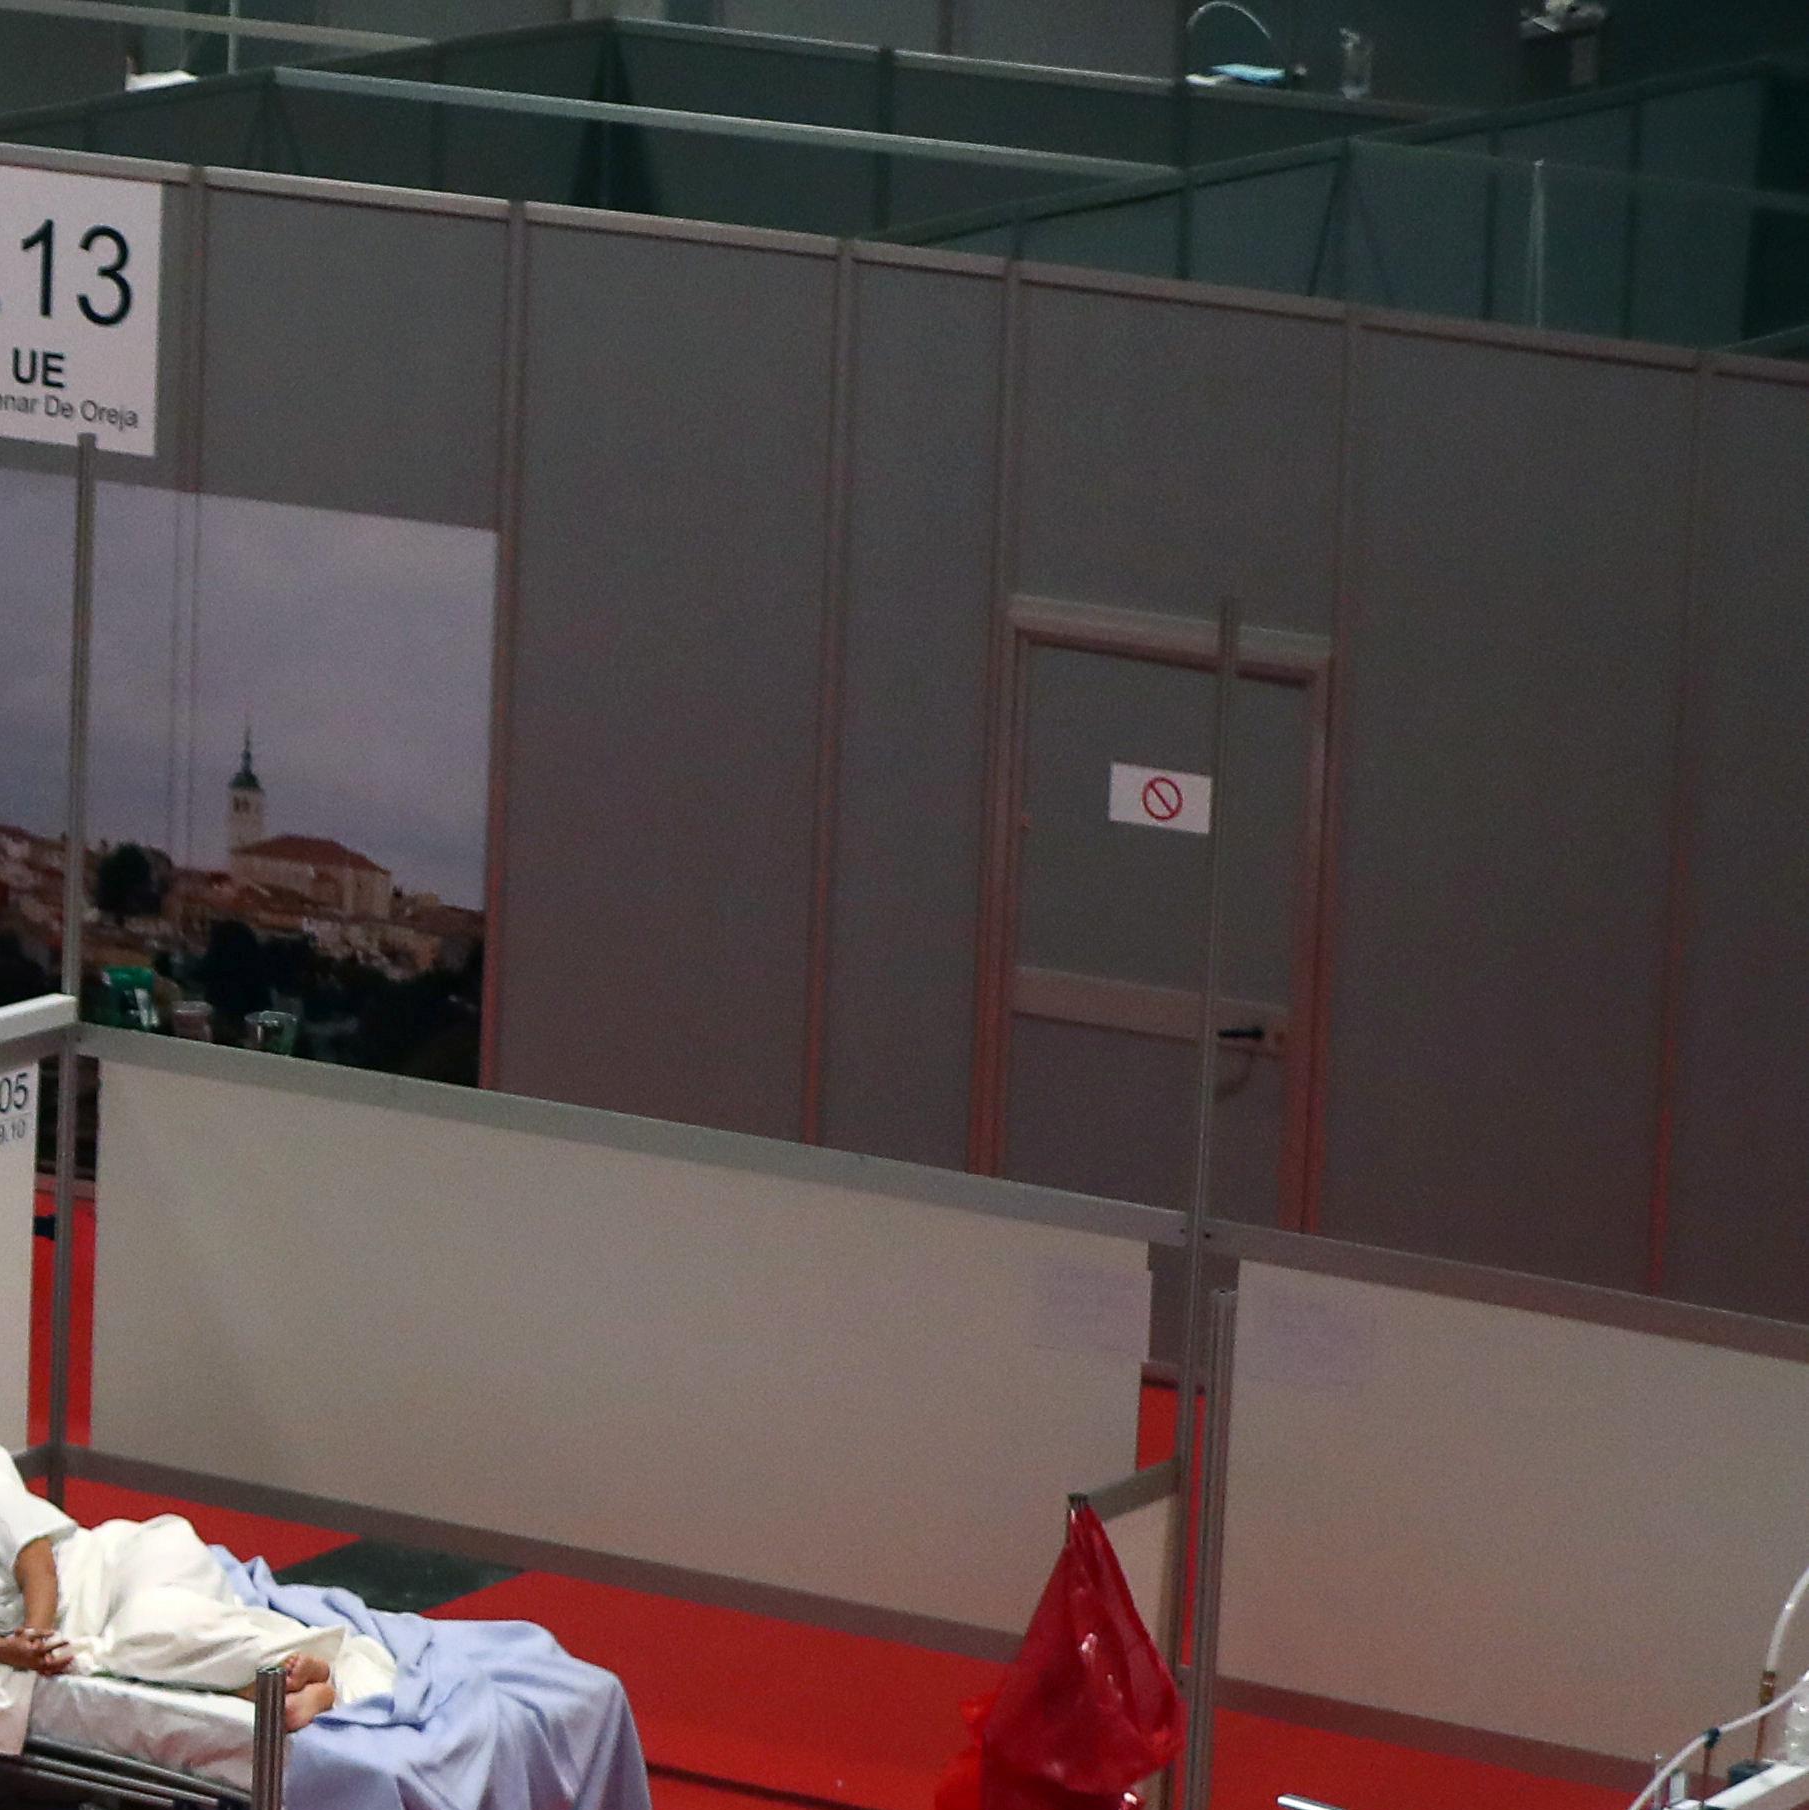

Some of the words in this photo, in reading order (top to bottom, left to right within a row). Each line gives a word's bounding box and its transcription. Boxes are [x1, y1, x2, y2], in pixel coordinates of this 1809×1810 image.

[12, 347, 66, 389] UE
[44, 395, 74, 419] De
[80, 400, 139, 432] Oreja
